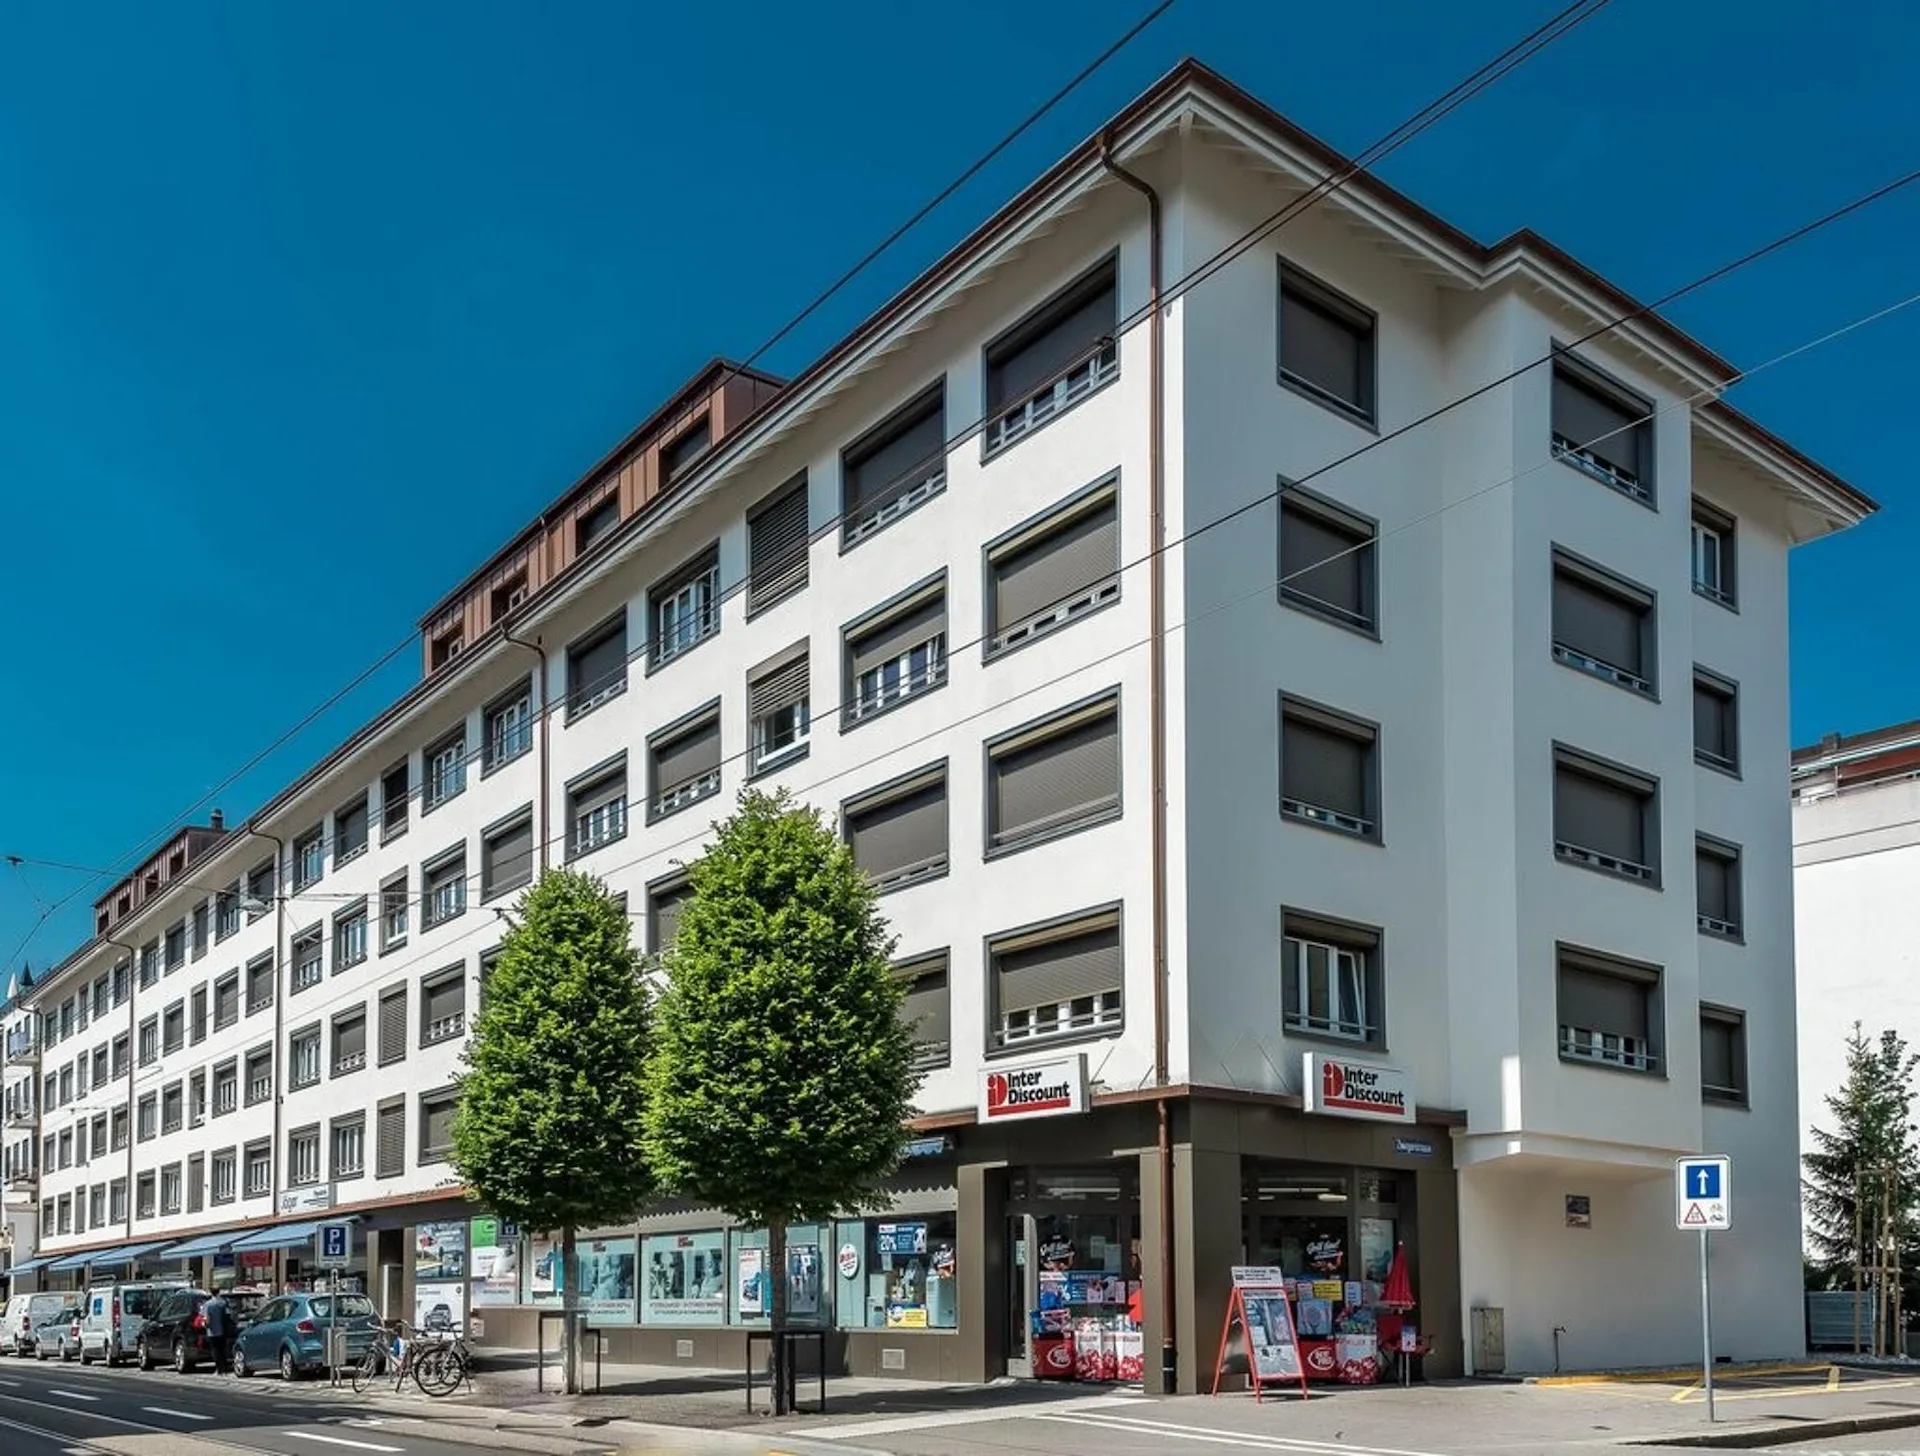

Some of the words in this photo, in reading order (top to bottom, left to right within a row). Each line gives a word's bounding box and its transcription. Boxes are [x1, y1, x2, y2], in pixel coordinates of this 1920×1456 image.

[1008, 1071, 1042, 1088] Inter
[1344, 1066, 1379, 1086] Inter
[1008, 1081, 1070, 1104] Discount
[1345, 1084, 1405, 1106] Discount
[329, 1229, 340, 1244] P
